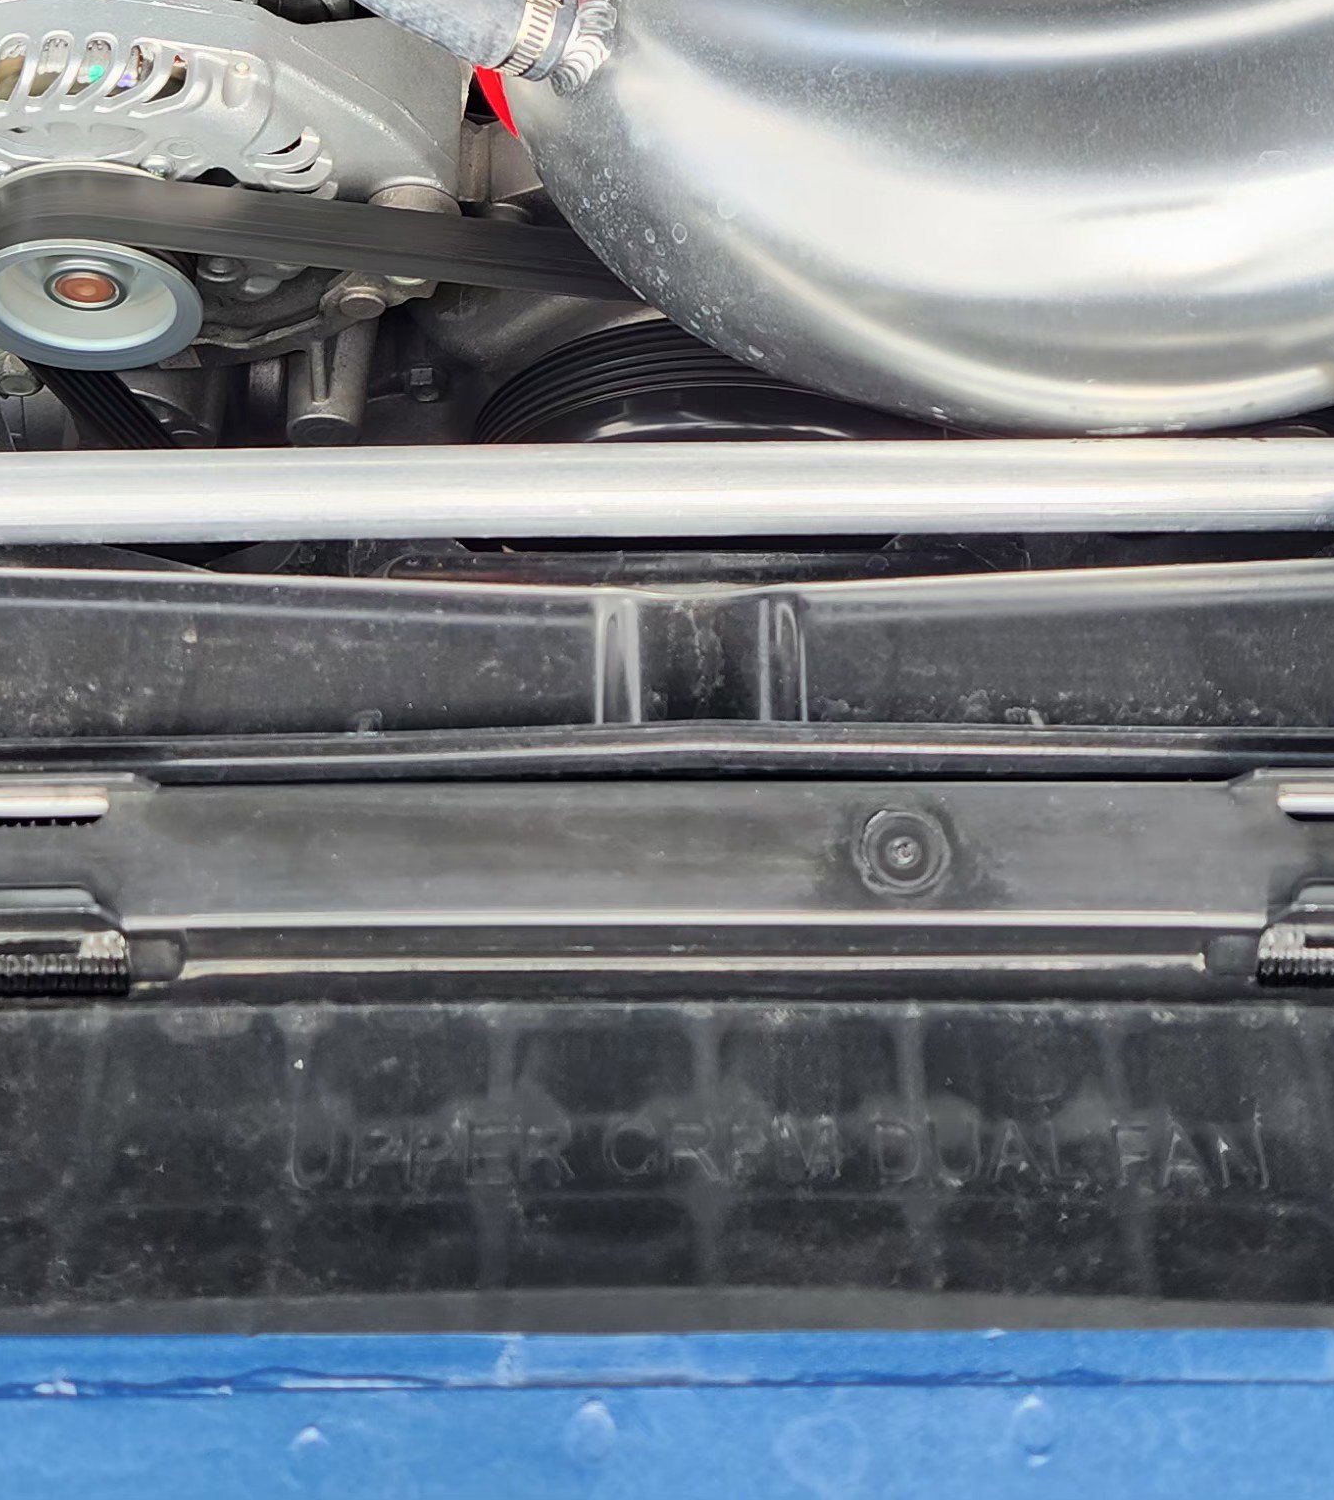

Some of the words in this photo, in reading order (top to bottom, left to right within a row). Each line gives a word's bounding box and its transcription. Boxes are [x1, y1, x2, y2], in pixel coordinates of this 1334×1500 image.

[285, 1118, 574, 1190] UPPER
[873, 1113, 1082, 1188] DUAL
[1111, 1105, 1270, 1190] FAN
